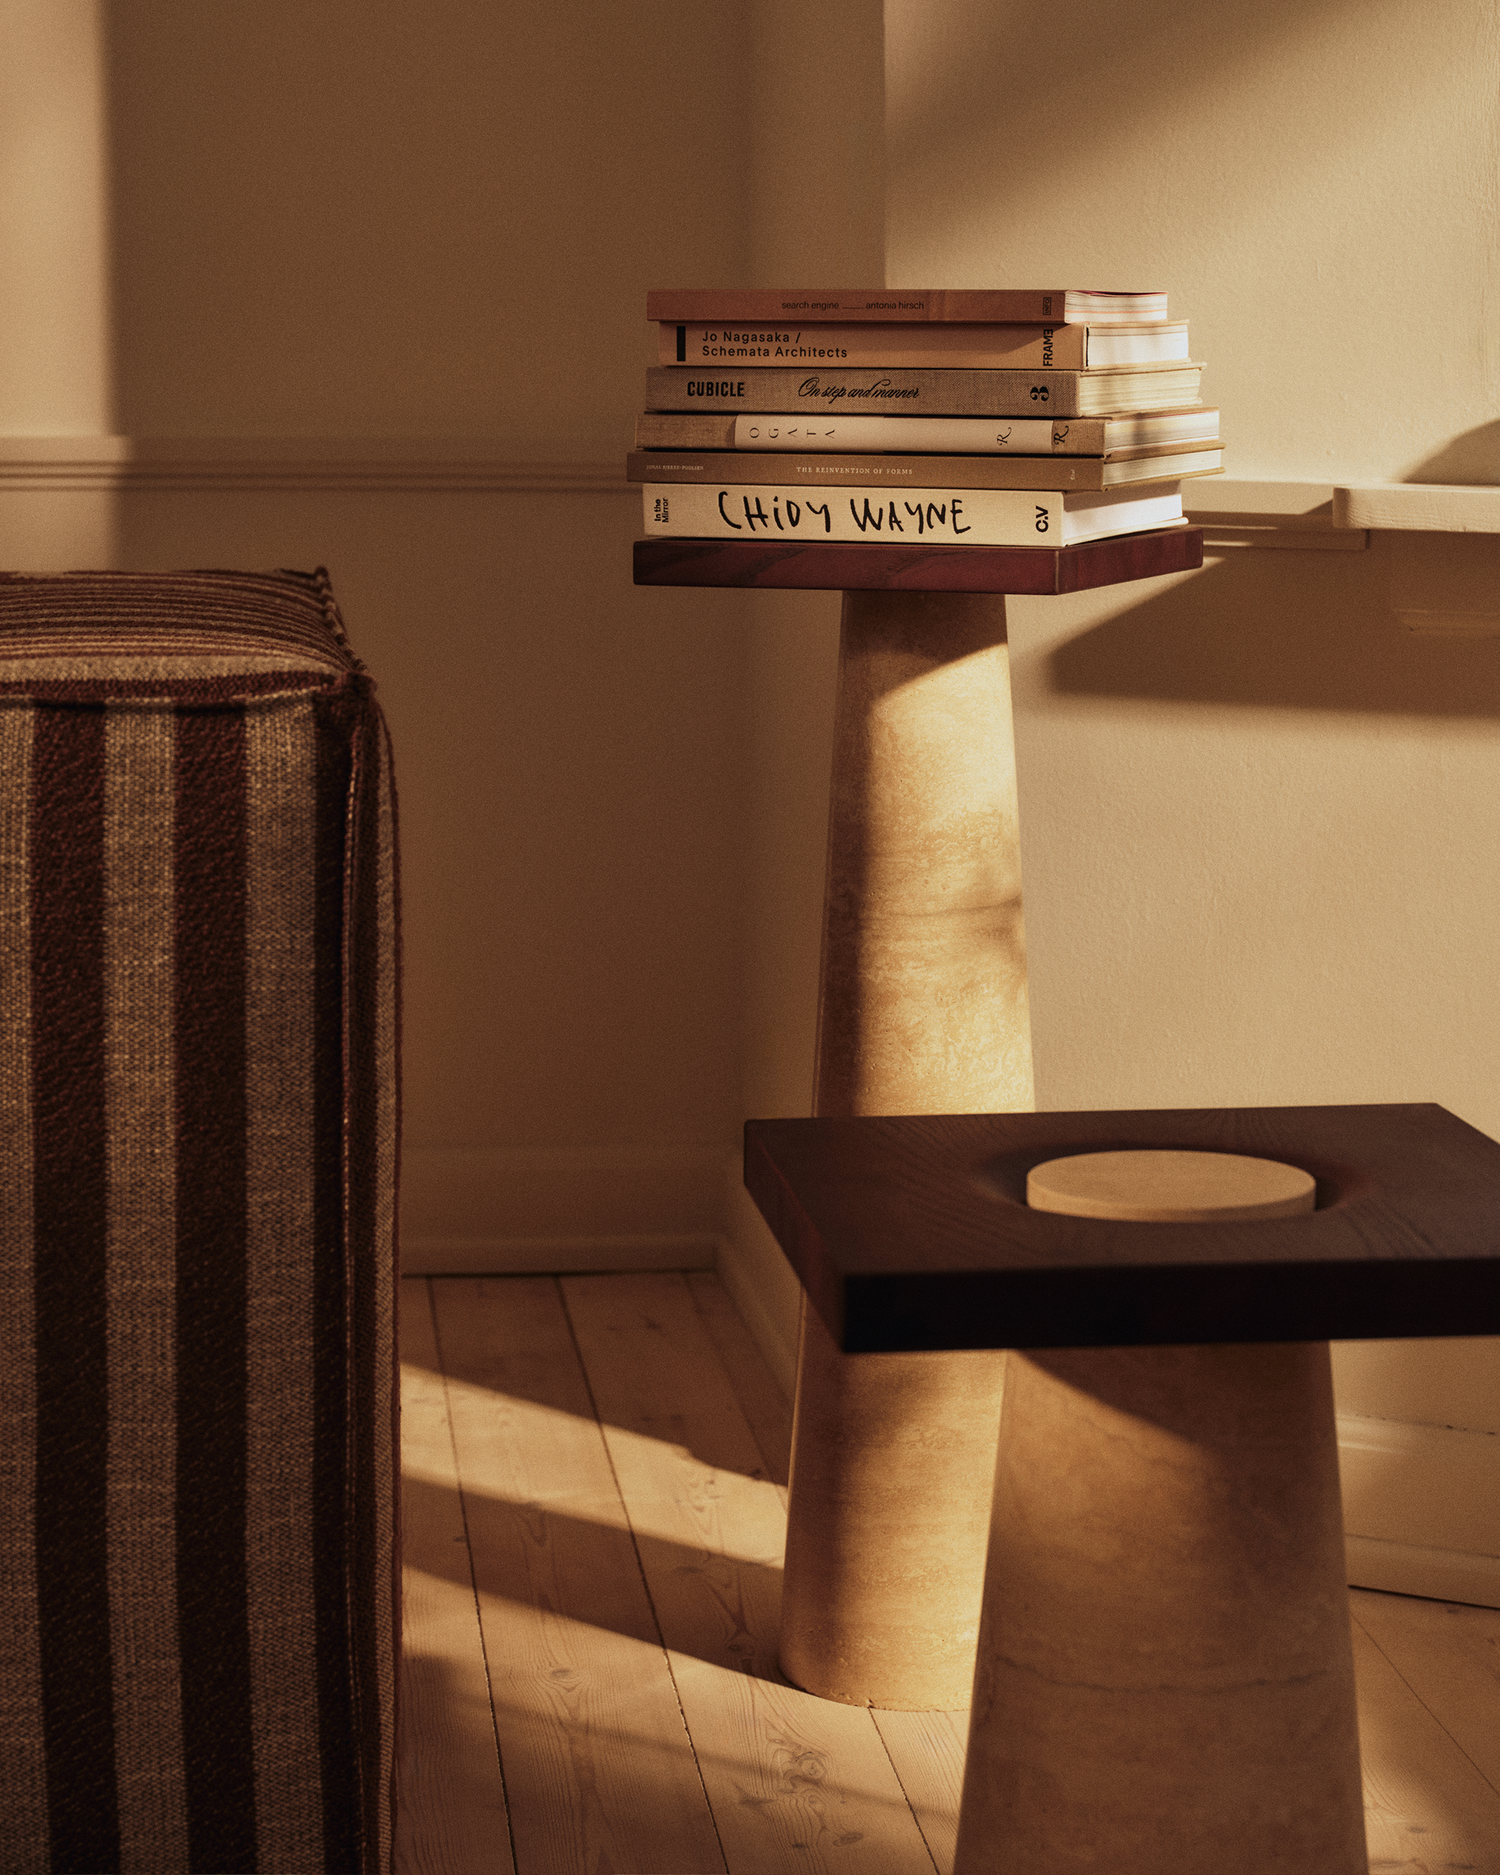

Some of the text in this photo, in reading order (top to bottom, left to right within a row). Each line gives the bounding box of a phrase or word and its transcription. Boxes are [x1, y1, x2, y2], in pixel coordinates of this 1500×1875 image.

[782, 301, 924, 311] search engine antonia hirsch
[702, 331, 718, 342] Jo
[723, 331, 790, 344] Nagasaka
[702, 345, 848, 358] Schemata Architects
[687, 381, 745, 397] CUBICLE
[798, 377, 919, 404] On step and manner
[1030, 386, 1049, 401] 3
[997, 426, 1012, 446] R
[1053, 425, 1069, 445] R
[654, 513, 661, 521] In
[850, 498, 971, 534] WAYNE
[1036, 505, 1049, 533] C.V
